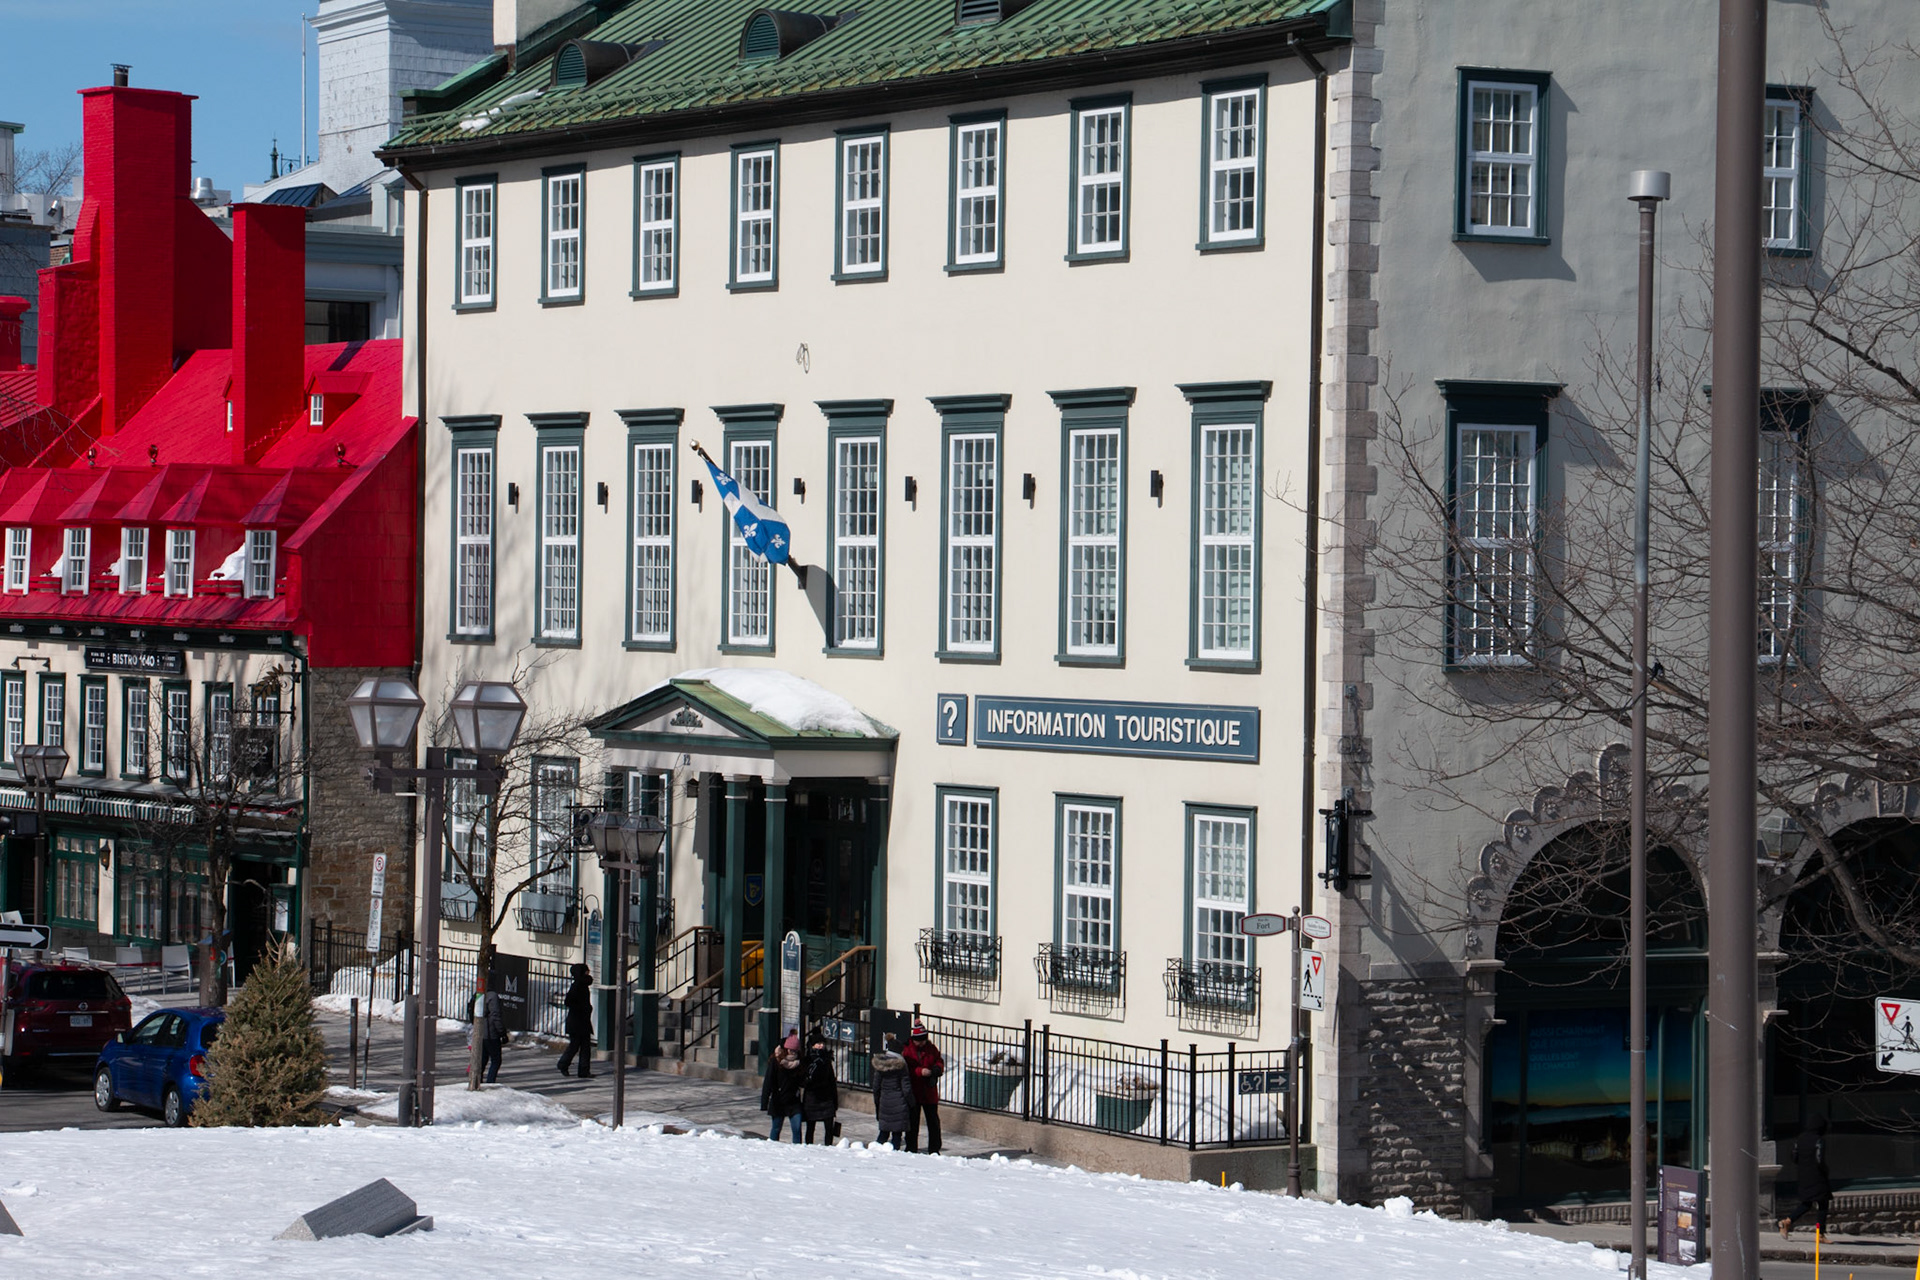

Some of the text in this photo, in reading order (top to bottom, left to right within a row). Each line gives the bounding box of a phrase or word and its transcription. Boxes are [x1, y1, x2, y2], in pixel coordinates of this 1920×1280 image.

[112, 653, 138, 666] BISTRO
[943, 700, 959, 738] ?
[987, 708, 1241, 746] INFORMATION TOURISTIQUE
[1256, 922, 1271, 930] Fort
